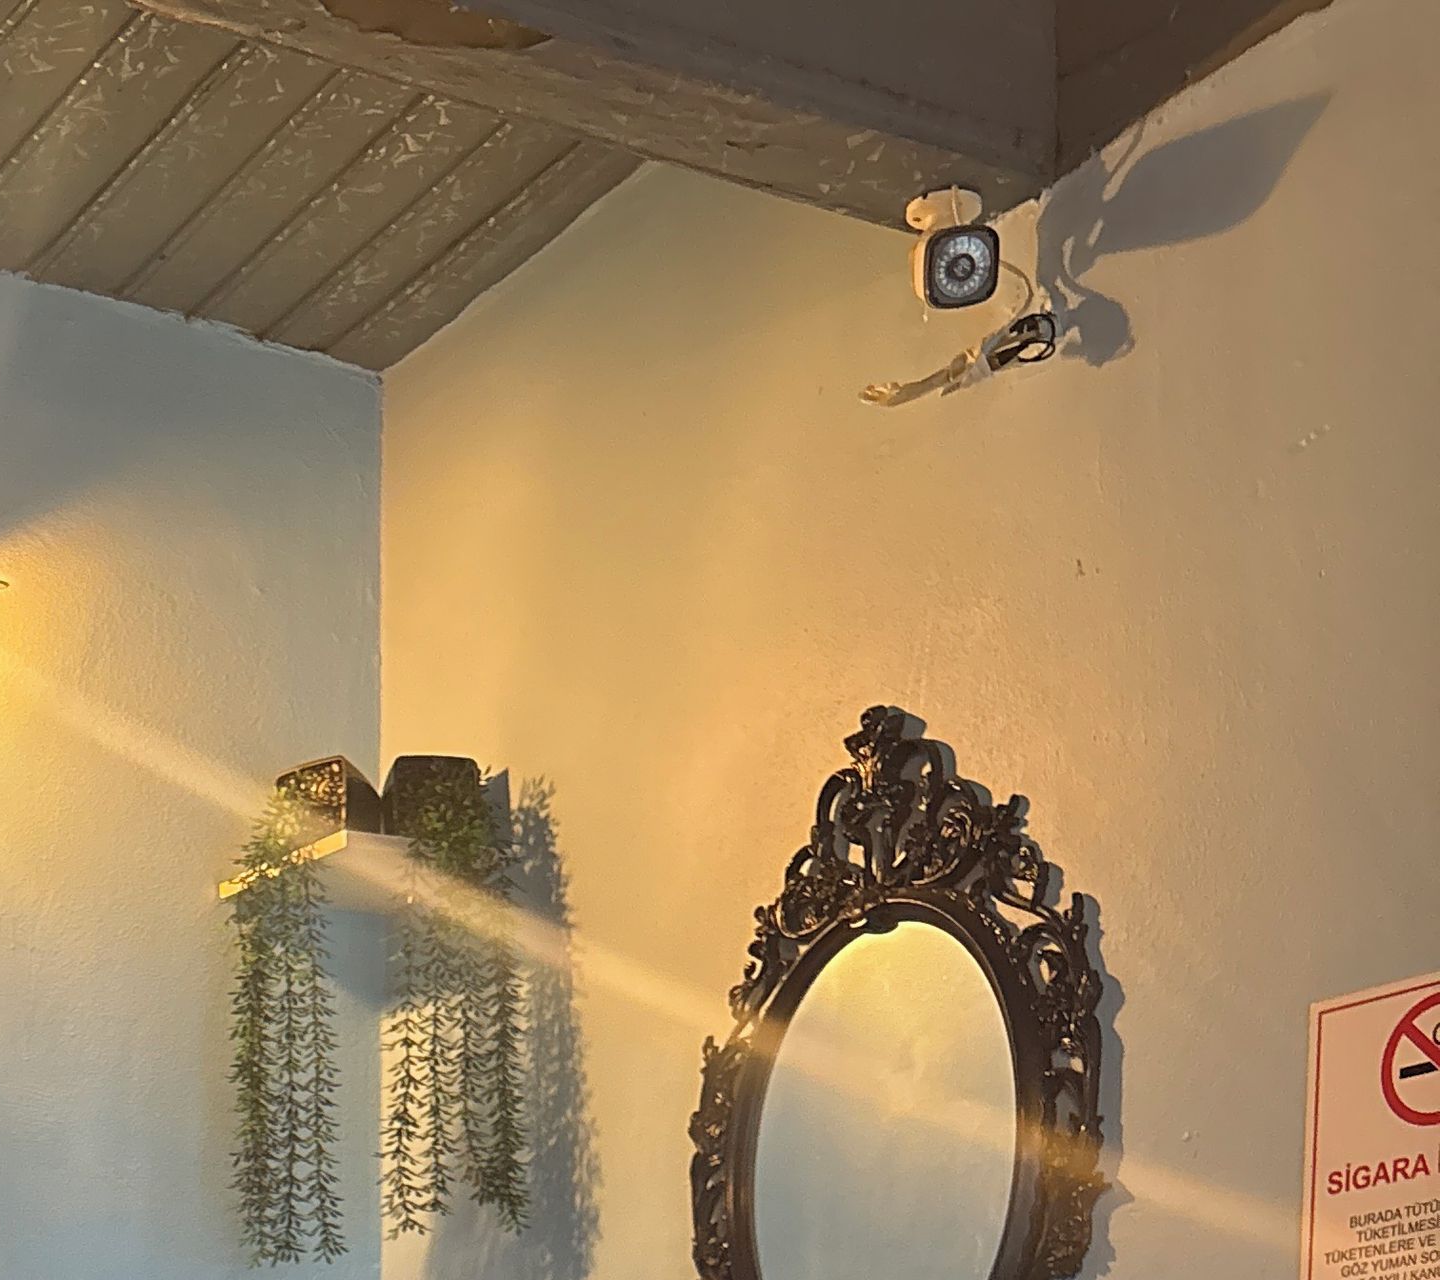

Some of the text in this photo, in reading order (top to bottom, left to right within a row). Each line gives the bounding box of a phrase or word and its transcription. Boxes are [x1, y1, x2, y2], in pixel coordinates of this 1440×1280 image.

[1327, 1153, 1430, 1195] SİGARA
[1349, 1208, 1402, 1229] BURADA
[1324, 1234, 1436, 1265] TÜKETENLERE VE
[1341, 1261, 1368, 1278] GÖZ
[1371, 1254, 1417, 1273] YUMAN
